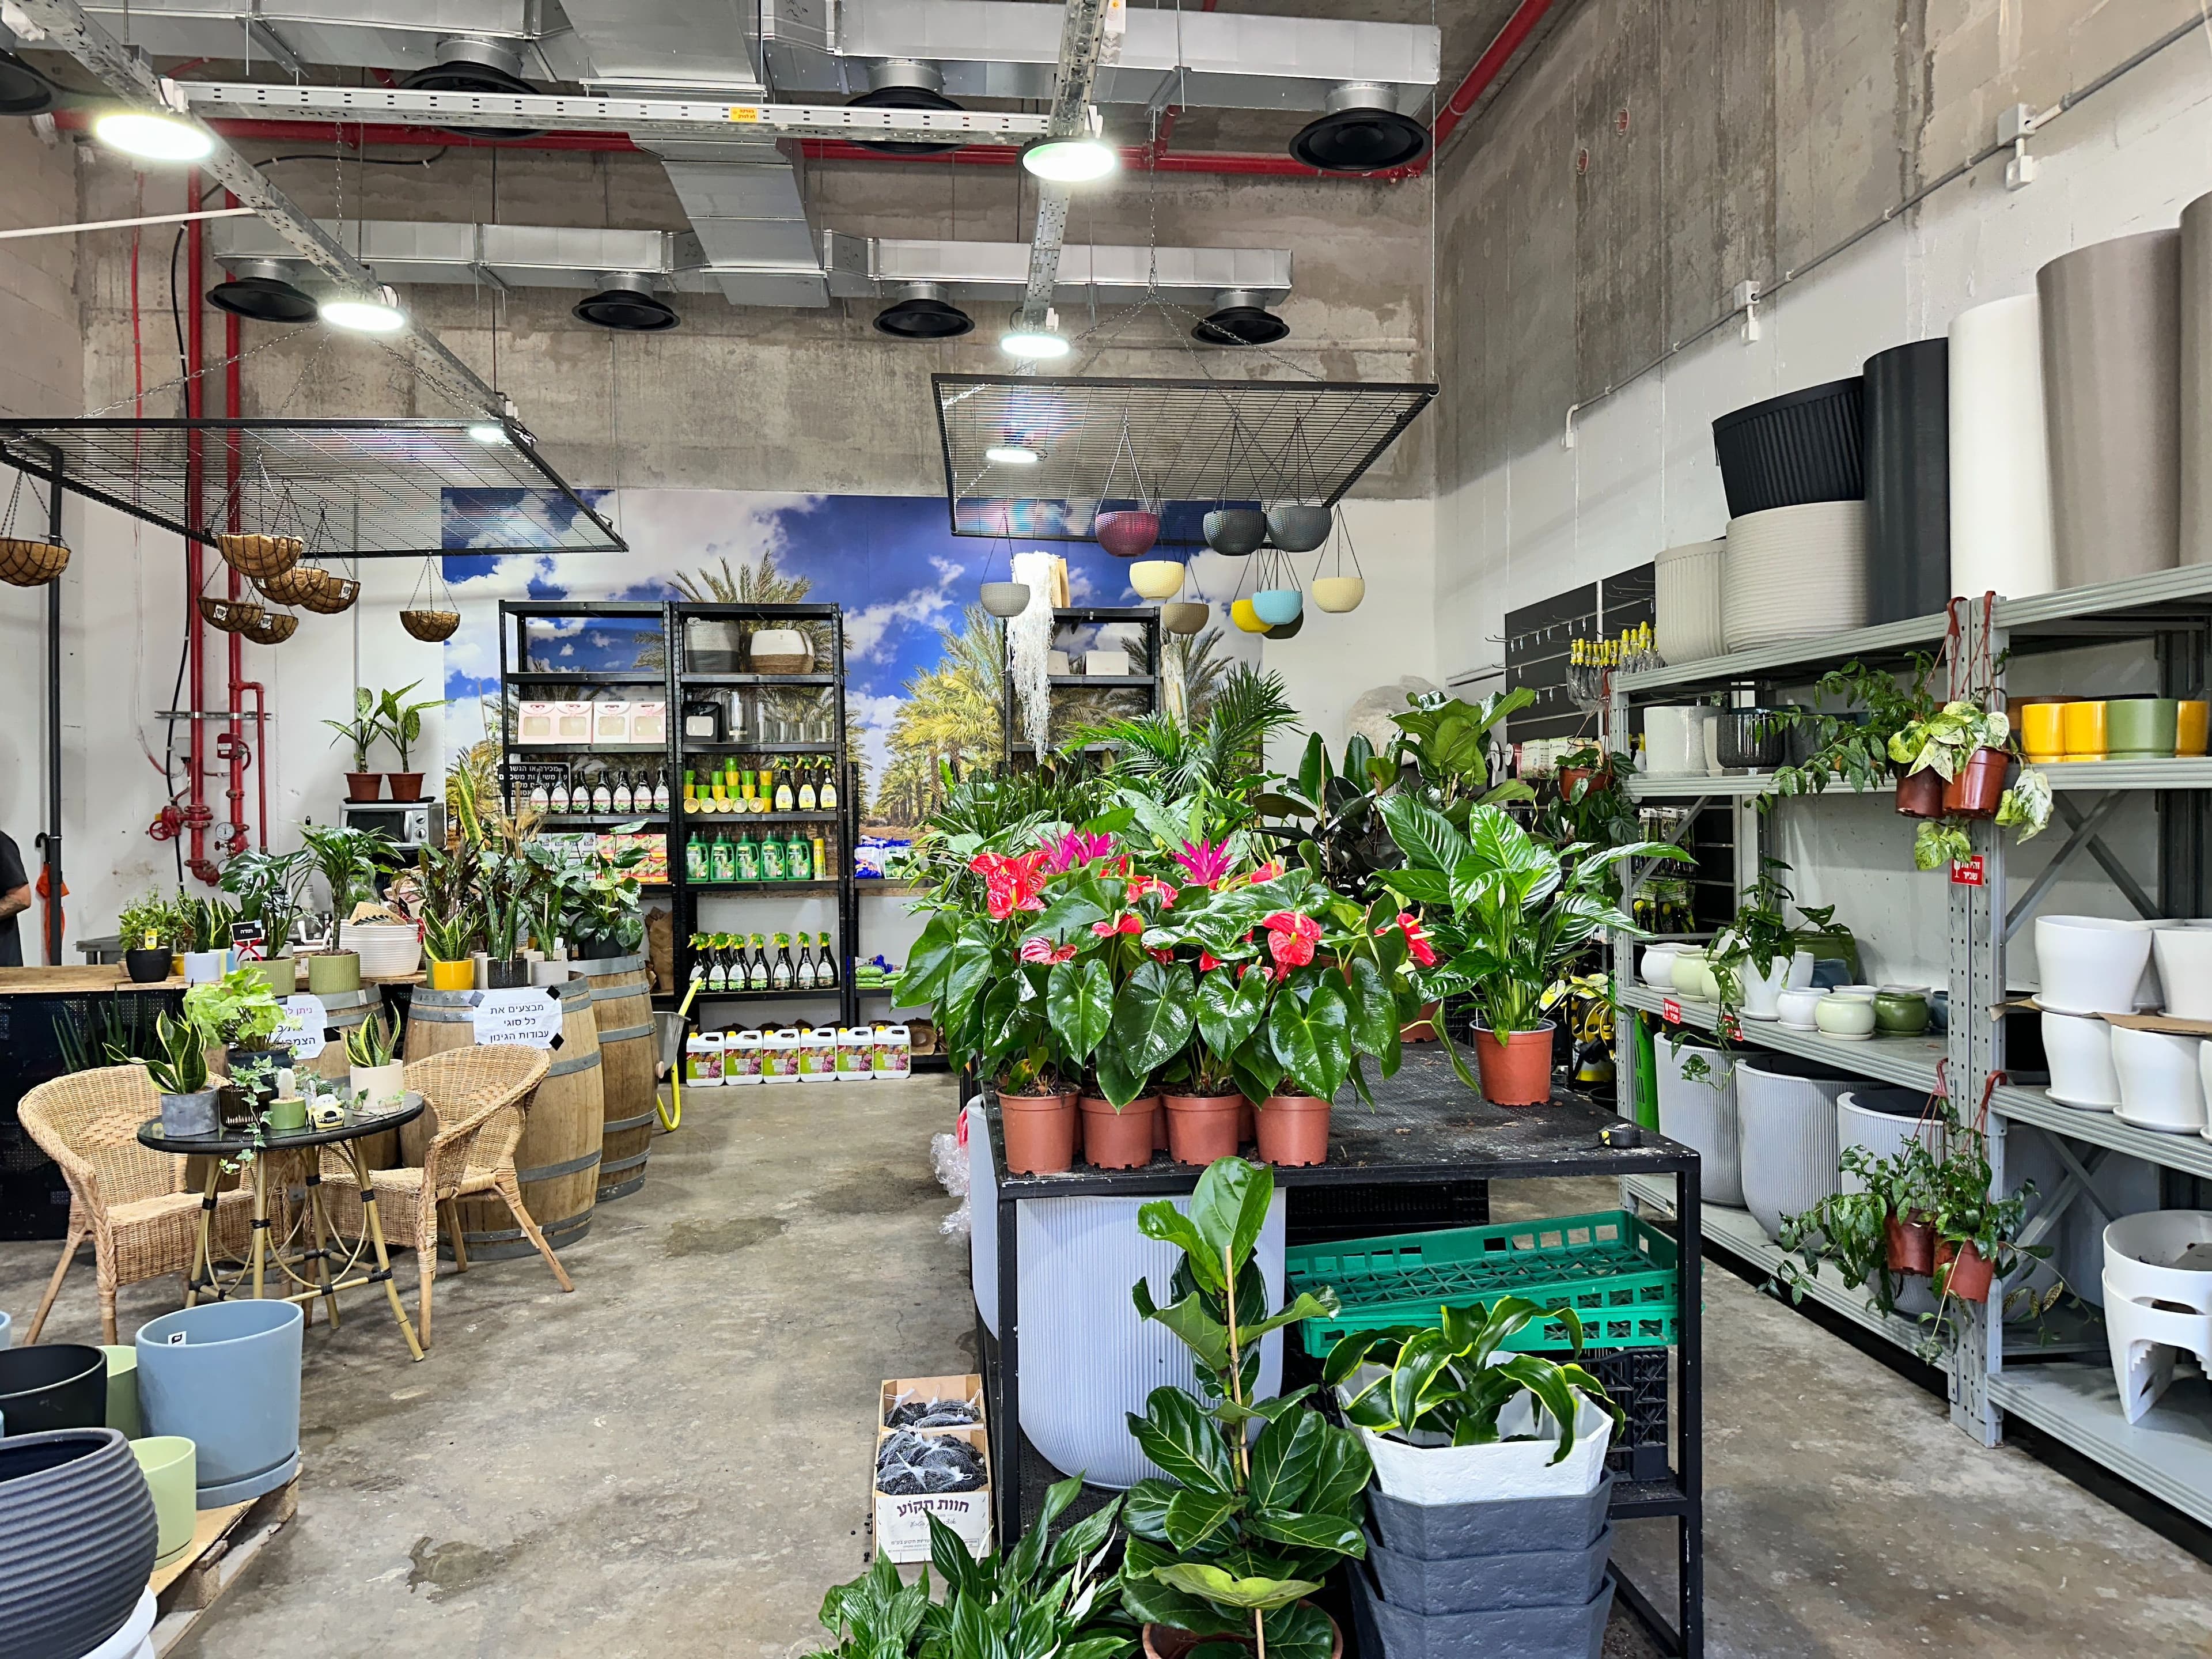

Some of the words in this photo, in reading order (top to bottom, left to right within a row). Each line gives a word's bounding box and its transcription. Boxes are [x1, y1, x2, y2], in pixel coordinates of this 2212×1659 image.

[297, 1007, 312, 1016] ניתן
[509, 1005, 544, 1013] מבצעים
[490, 1033, 515, 1043] הגינון
[519, 1031, 549, 1039] עבודות
[937, 1499, 969, 1513] חוות
